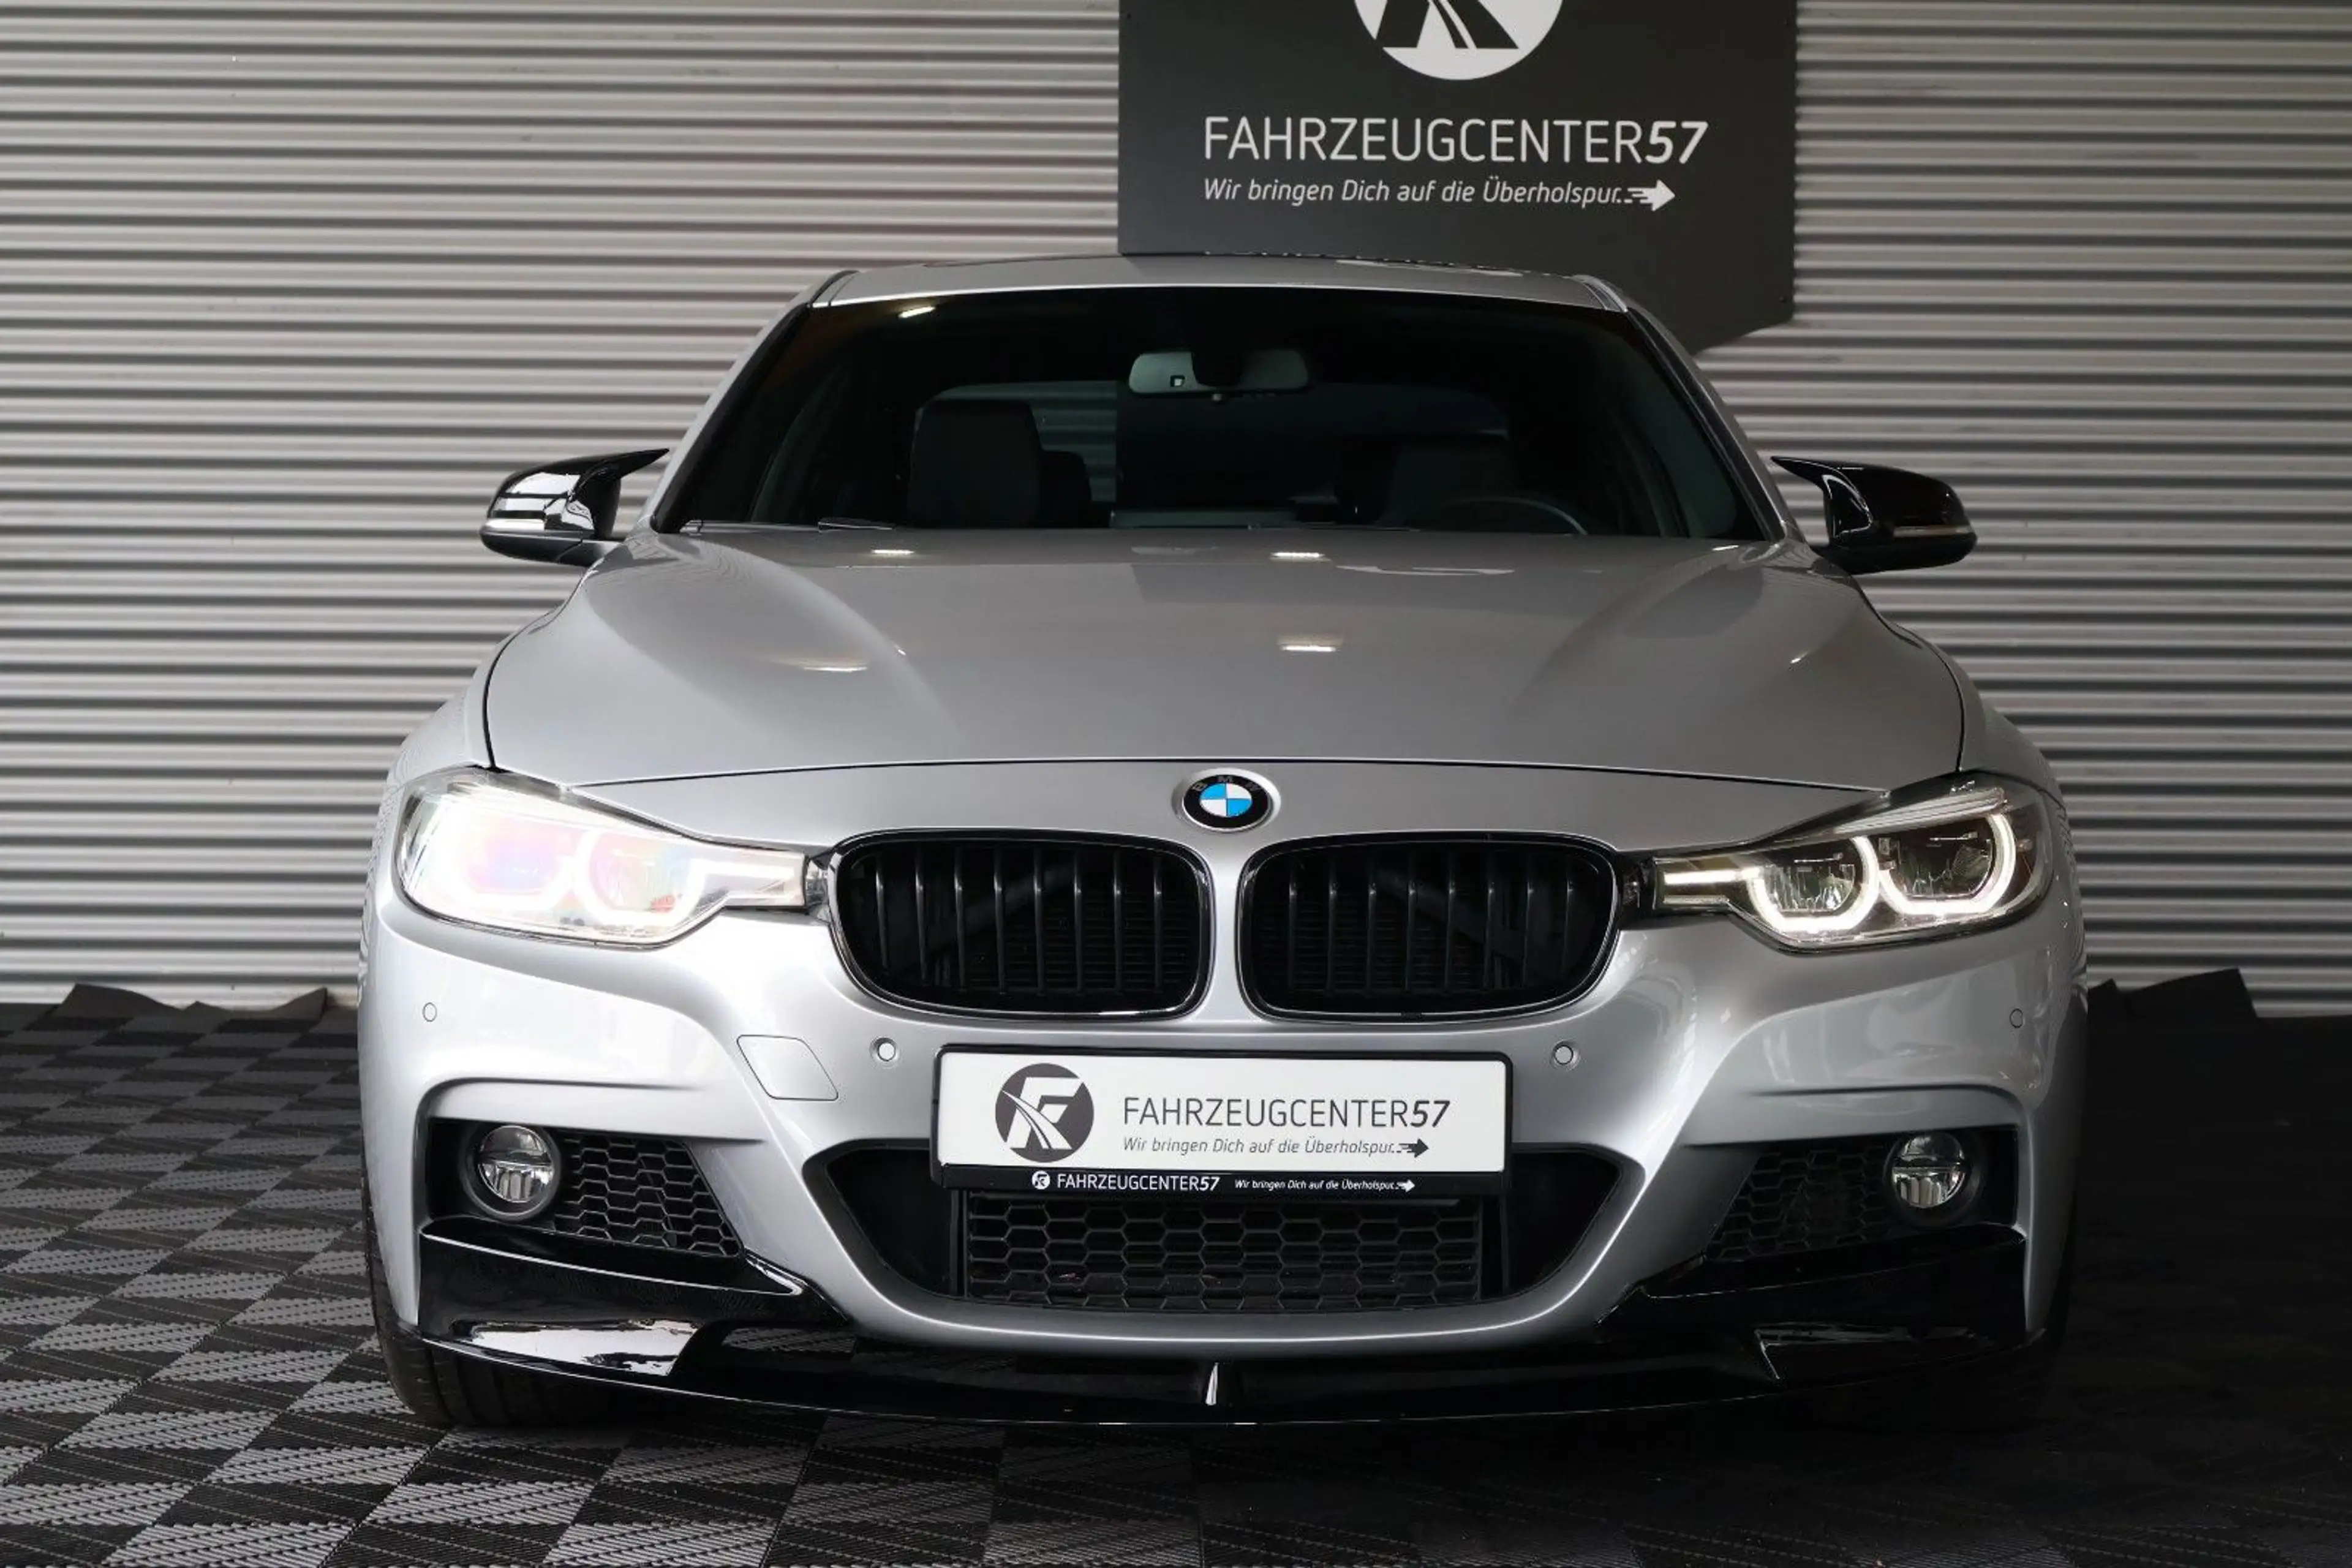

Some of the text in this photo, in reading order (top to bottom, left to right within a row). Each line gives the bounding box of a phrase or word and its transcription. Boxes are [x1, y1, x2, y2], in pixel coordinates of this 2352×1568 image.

[1204, 116, 1709, 165] FAHRZEUGCENTER57
[1204, 178, 1242, 201] Wir
[1248, 178, 1334, 207] bringen
[1341, 179, 1390, 202] Dich
[1396, 179, 1436, 202] auf
[1441, 181, 1476, 202] die
[1123, 1097, 1451, 1128] FAHRZEUGCENTER57
[1123, 1137, 1147, 1152] Wir
[1152, 1137, 1208, 1157] bringen
[1212, 1138, 1245, 1154] Dich
[1249, 1139, 1274, 1154] auf
[1277, 1139, 1300, 1154] die
[1057, 1173, 1221, 1191] FAHRZEUGCENTER57
[1234, 1179, 1250, 1189] Wir
[1252, 1180, 1286, 1191] bringen
[1287, 1180, 1306, 1189] Dich
[1308, 1180, 1325, 1190] auf
[1325, 1180, 1340, 1189] die
